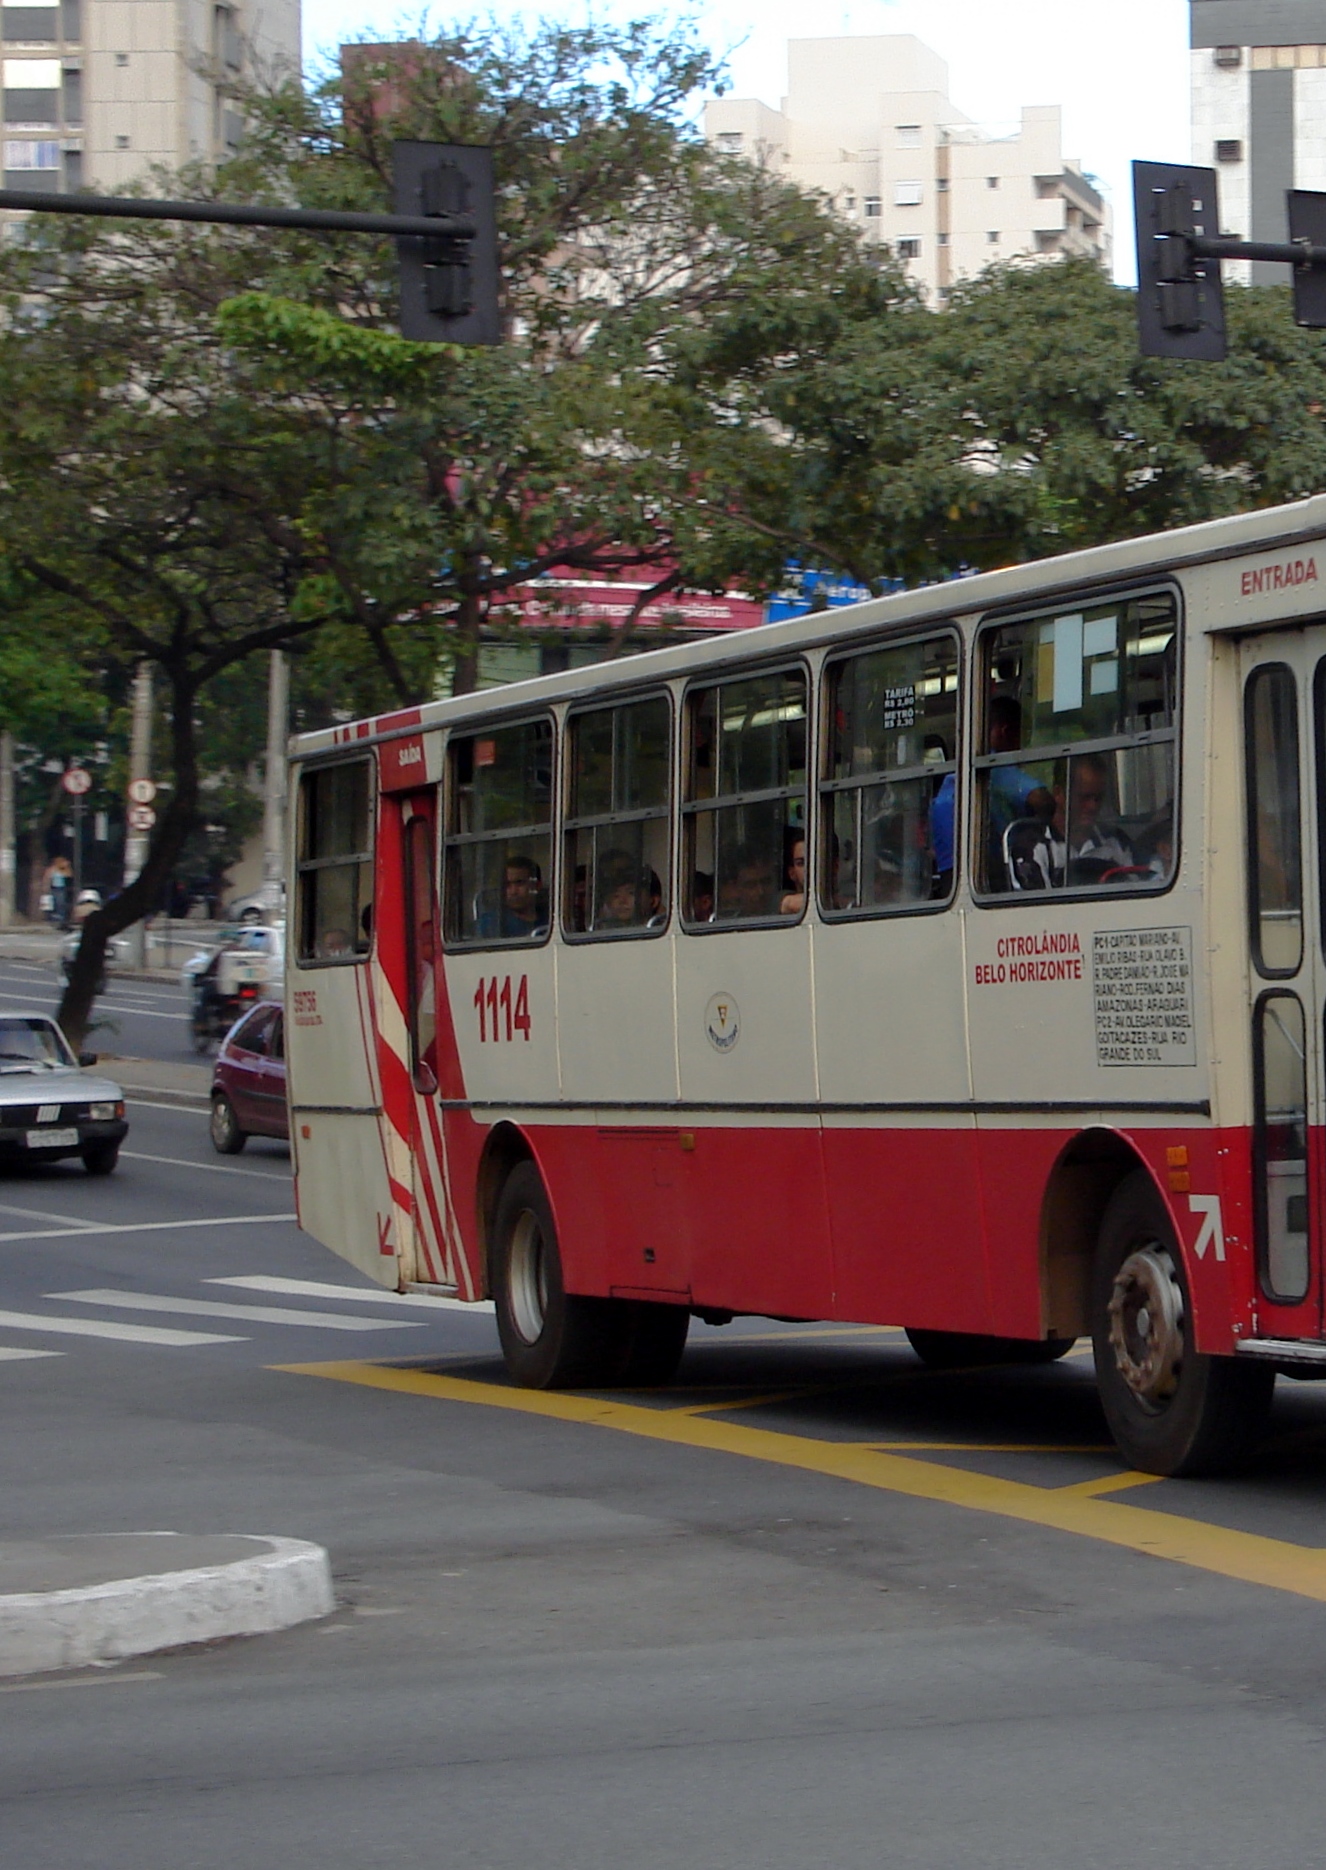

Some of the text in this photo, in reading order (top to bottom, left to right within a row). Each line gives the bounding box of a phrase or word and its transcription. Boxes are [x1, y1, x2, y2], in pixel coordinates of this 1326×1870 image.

[1242, 558, 1318, 595] ENTRADA
[885, 686, 914, 699] TARIFA
[398, 742, 422, 766] SAÍDA
[997, 930, 1081, 958] CITROLÂNDIA
[975, 959, 1082, 984] BELO HORIZONTE
[474, 974, 531, 1042] 1114
[1099, 1047, 1130, 1061] GRANDE
[1147, 1047, 1161, 1060] SUL
